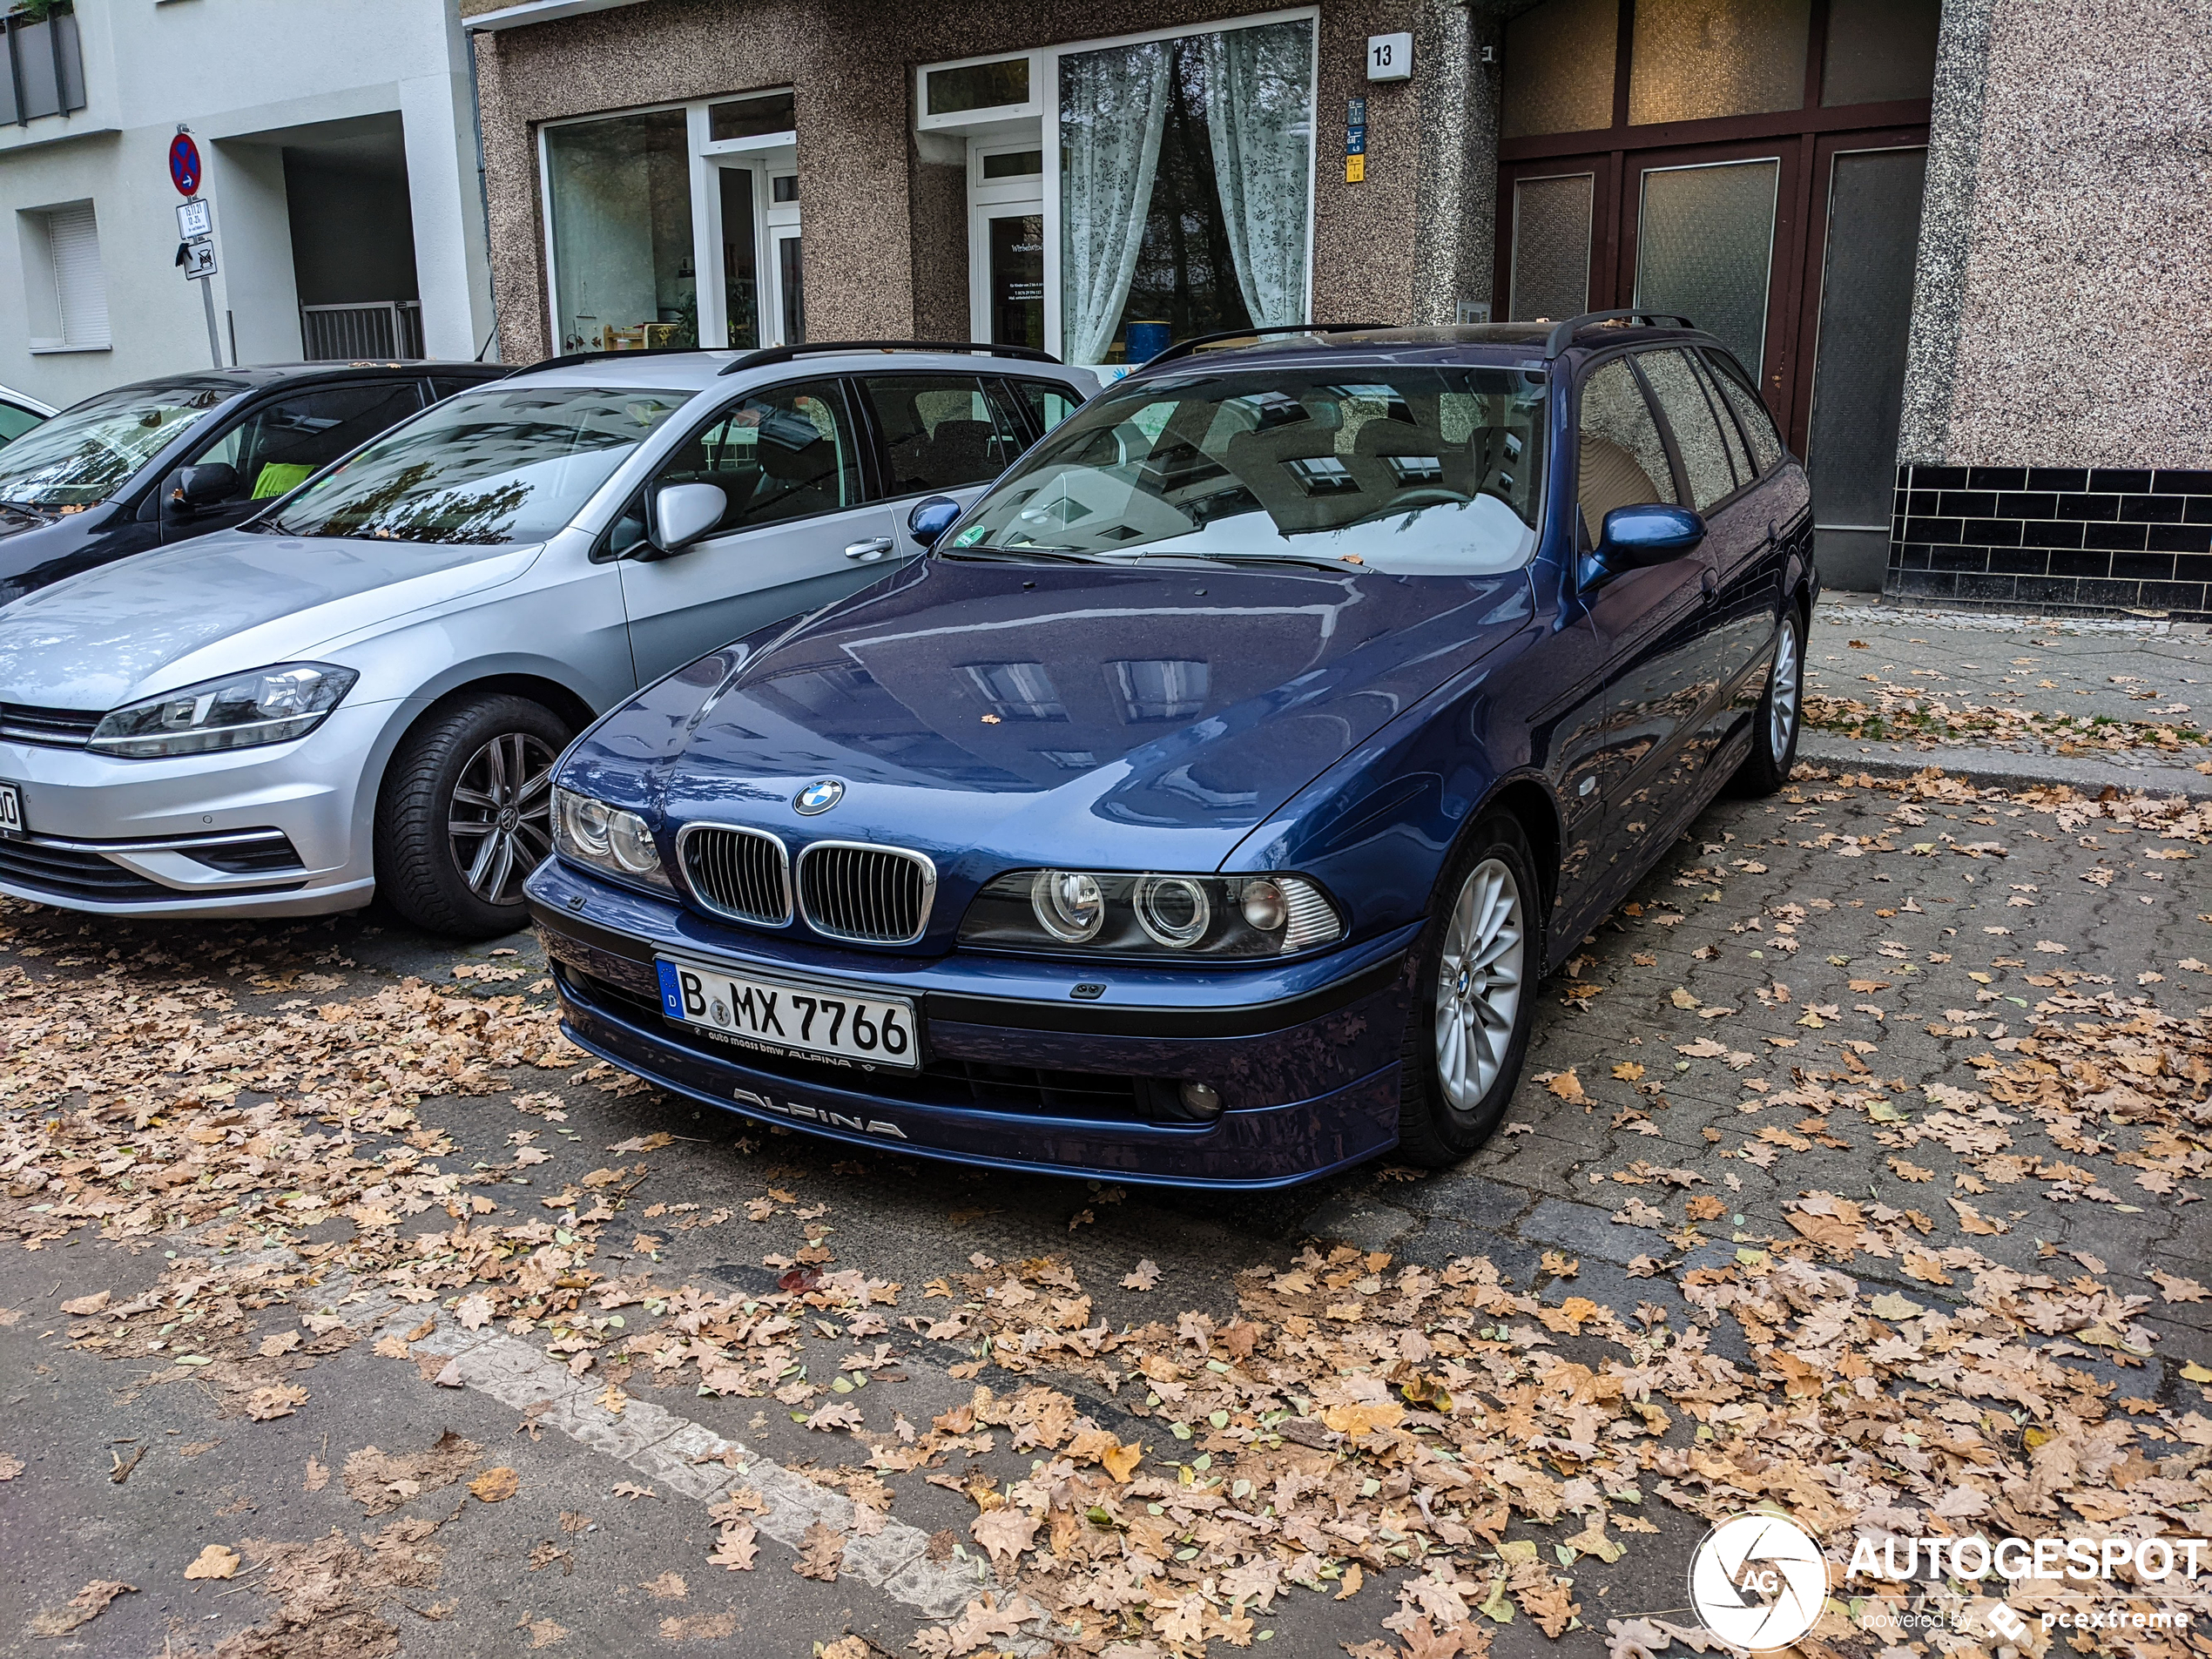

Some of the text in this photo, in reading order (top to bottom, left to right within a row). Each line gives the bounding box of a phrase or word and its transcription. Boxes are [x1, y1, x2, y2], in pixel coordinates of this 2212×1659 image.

[1373, 44, 1392, 66] 13
[668, 995, 677, 1007] D
[679, 971, 907, 1055] B MX 7766
[708, 1031, 853, 1068] auto maass bmw ALPINA
[733, 1088, 907, 1139] ALPINA
